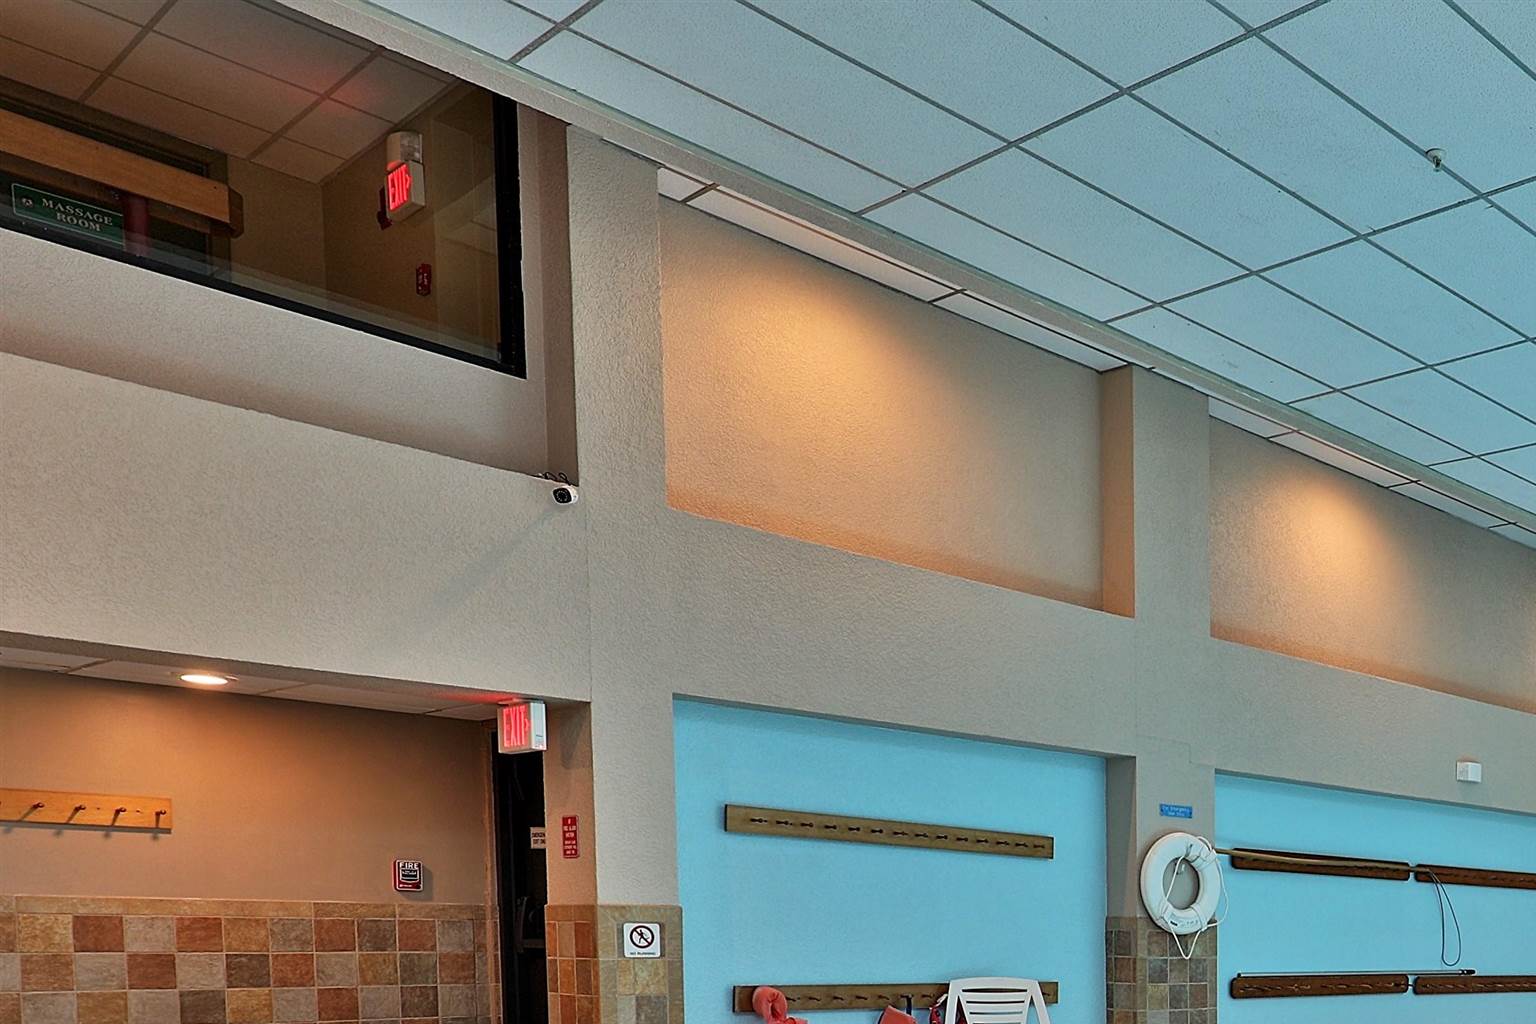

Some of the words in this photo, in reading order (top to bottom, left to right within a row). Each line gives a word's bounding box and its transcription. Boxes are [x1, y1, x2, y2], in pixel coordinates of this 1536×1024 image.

[387, 163, 409, 211] EXIT
[42, 198, 113, 226] MASSAGE
[56, 212, 101, 232] ROOM
[503, 704, 526, 748] EXIT
[400, 862, 419, 870] FIRE
